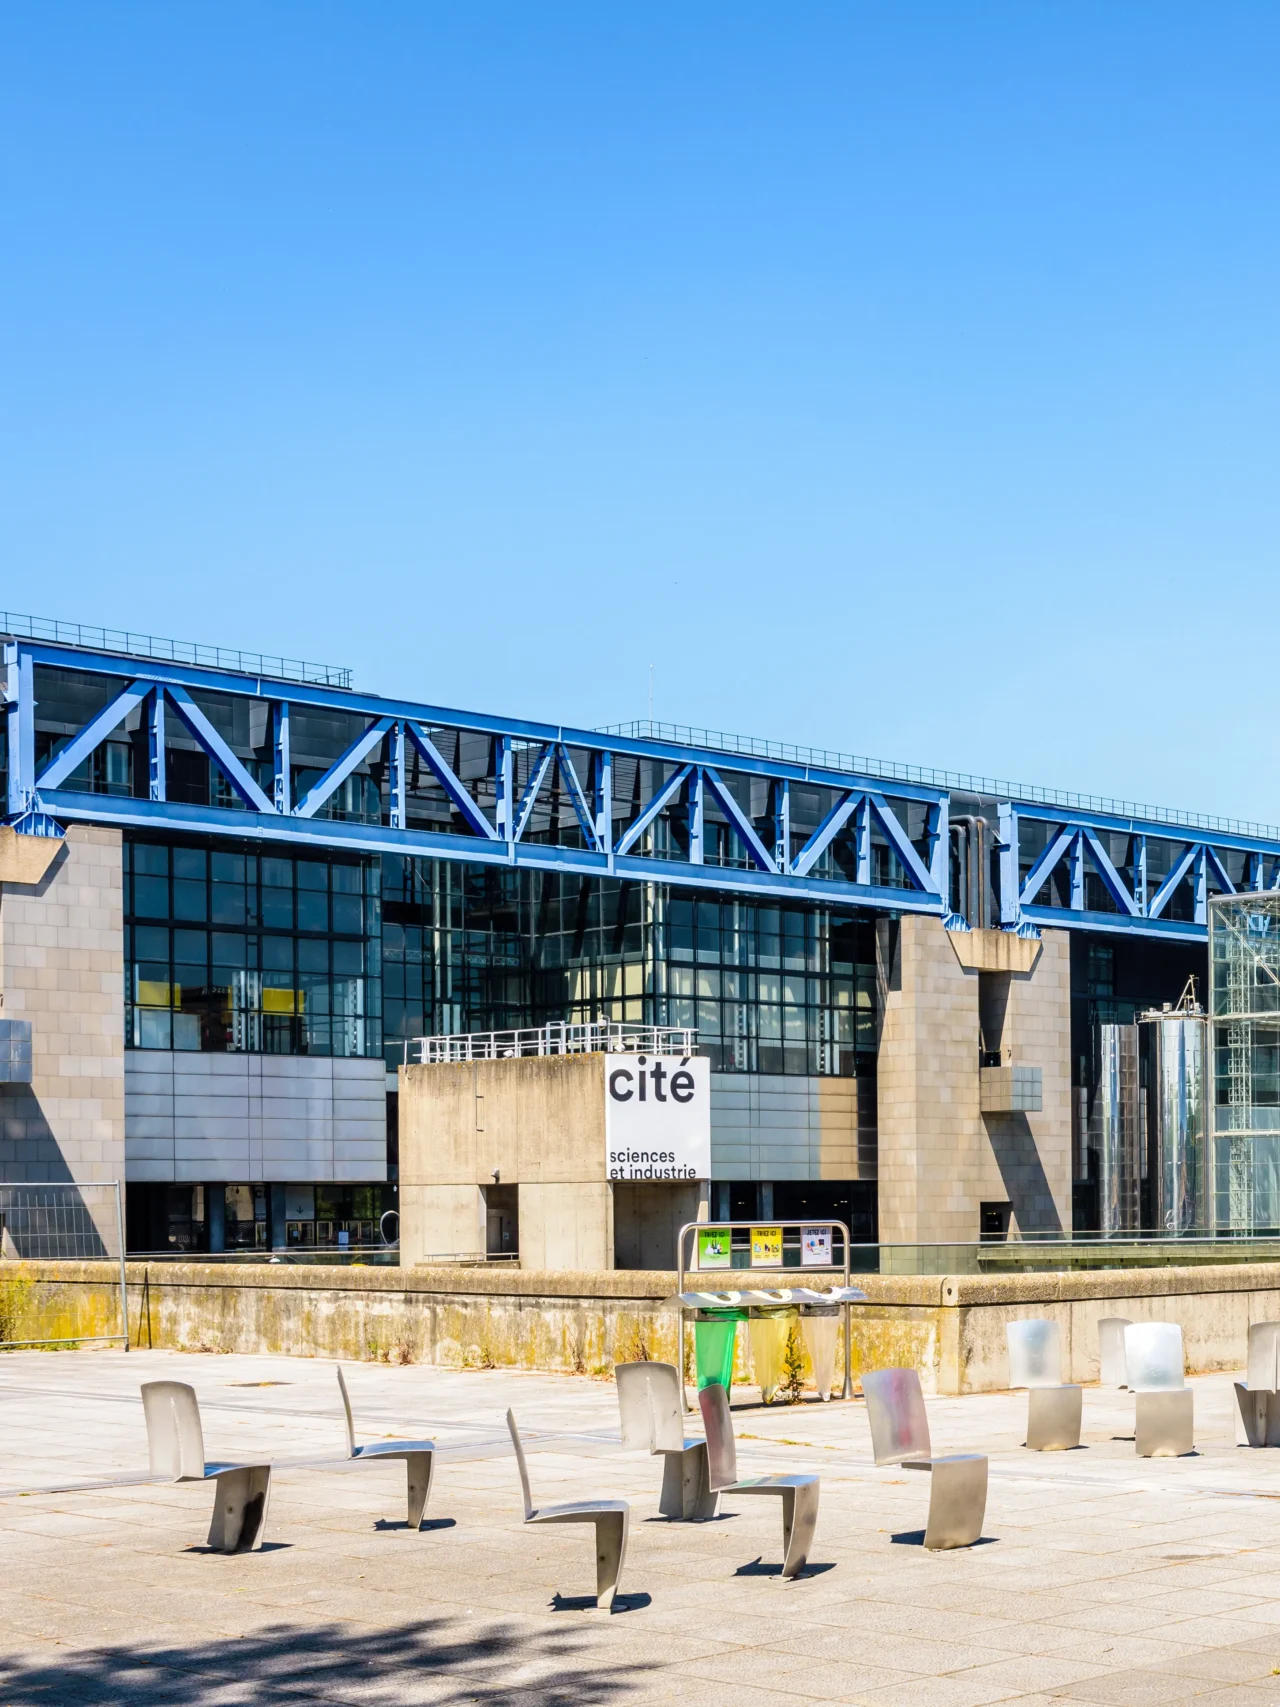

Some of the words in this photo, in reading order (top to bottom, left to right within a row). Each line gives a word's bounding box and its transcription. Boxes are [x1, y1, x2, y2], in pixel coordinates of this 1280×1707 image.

[609, 1055, 695, 1103] cité
[610, 1147, 675, 1163] sciences
[610, 1165, 625, 1179] et
[629, 1164, 697, 1179] industrie
